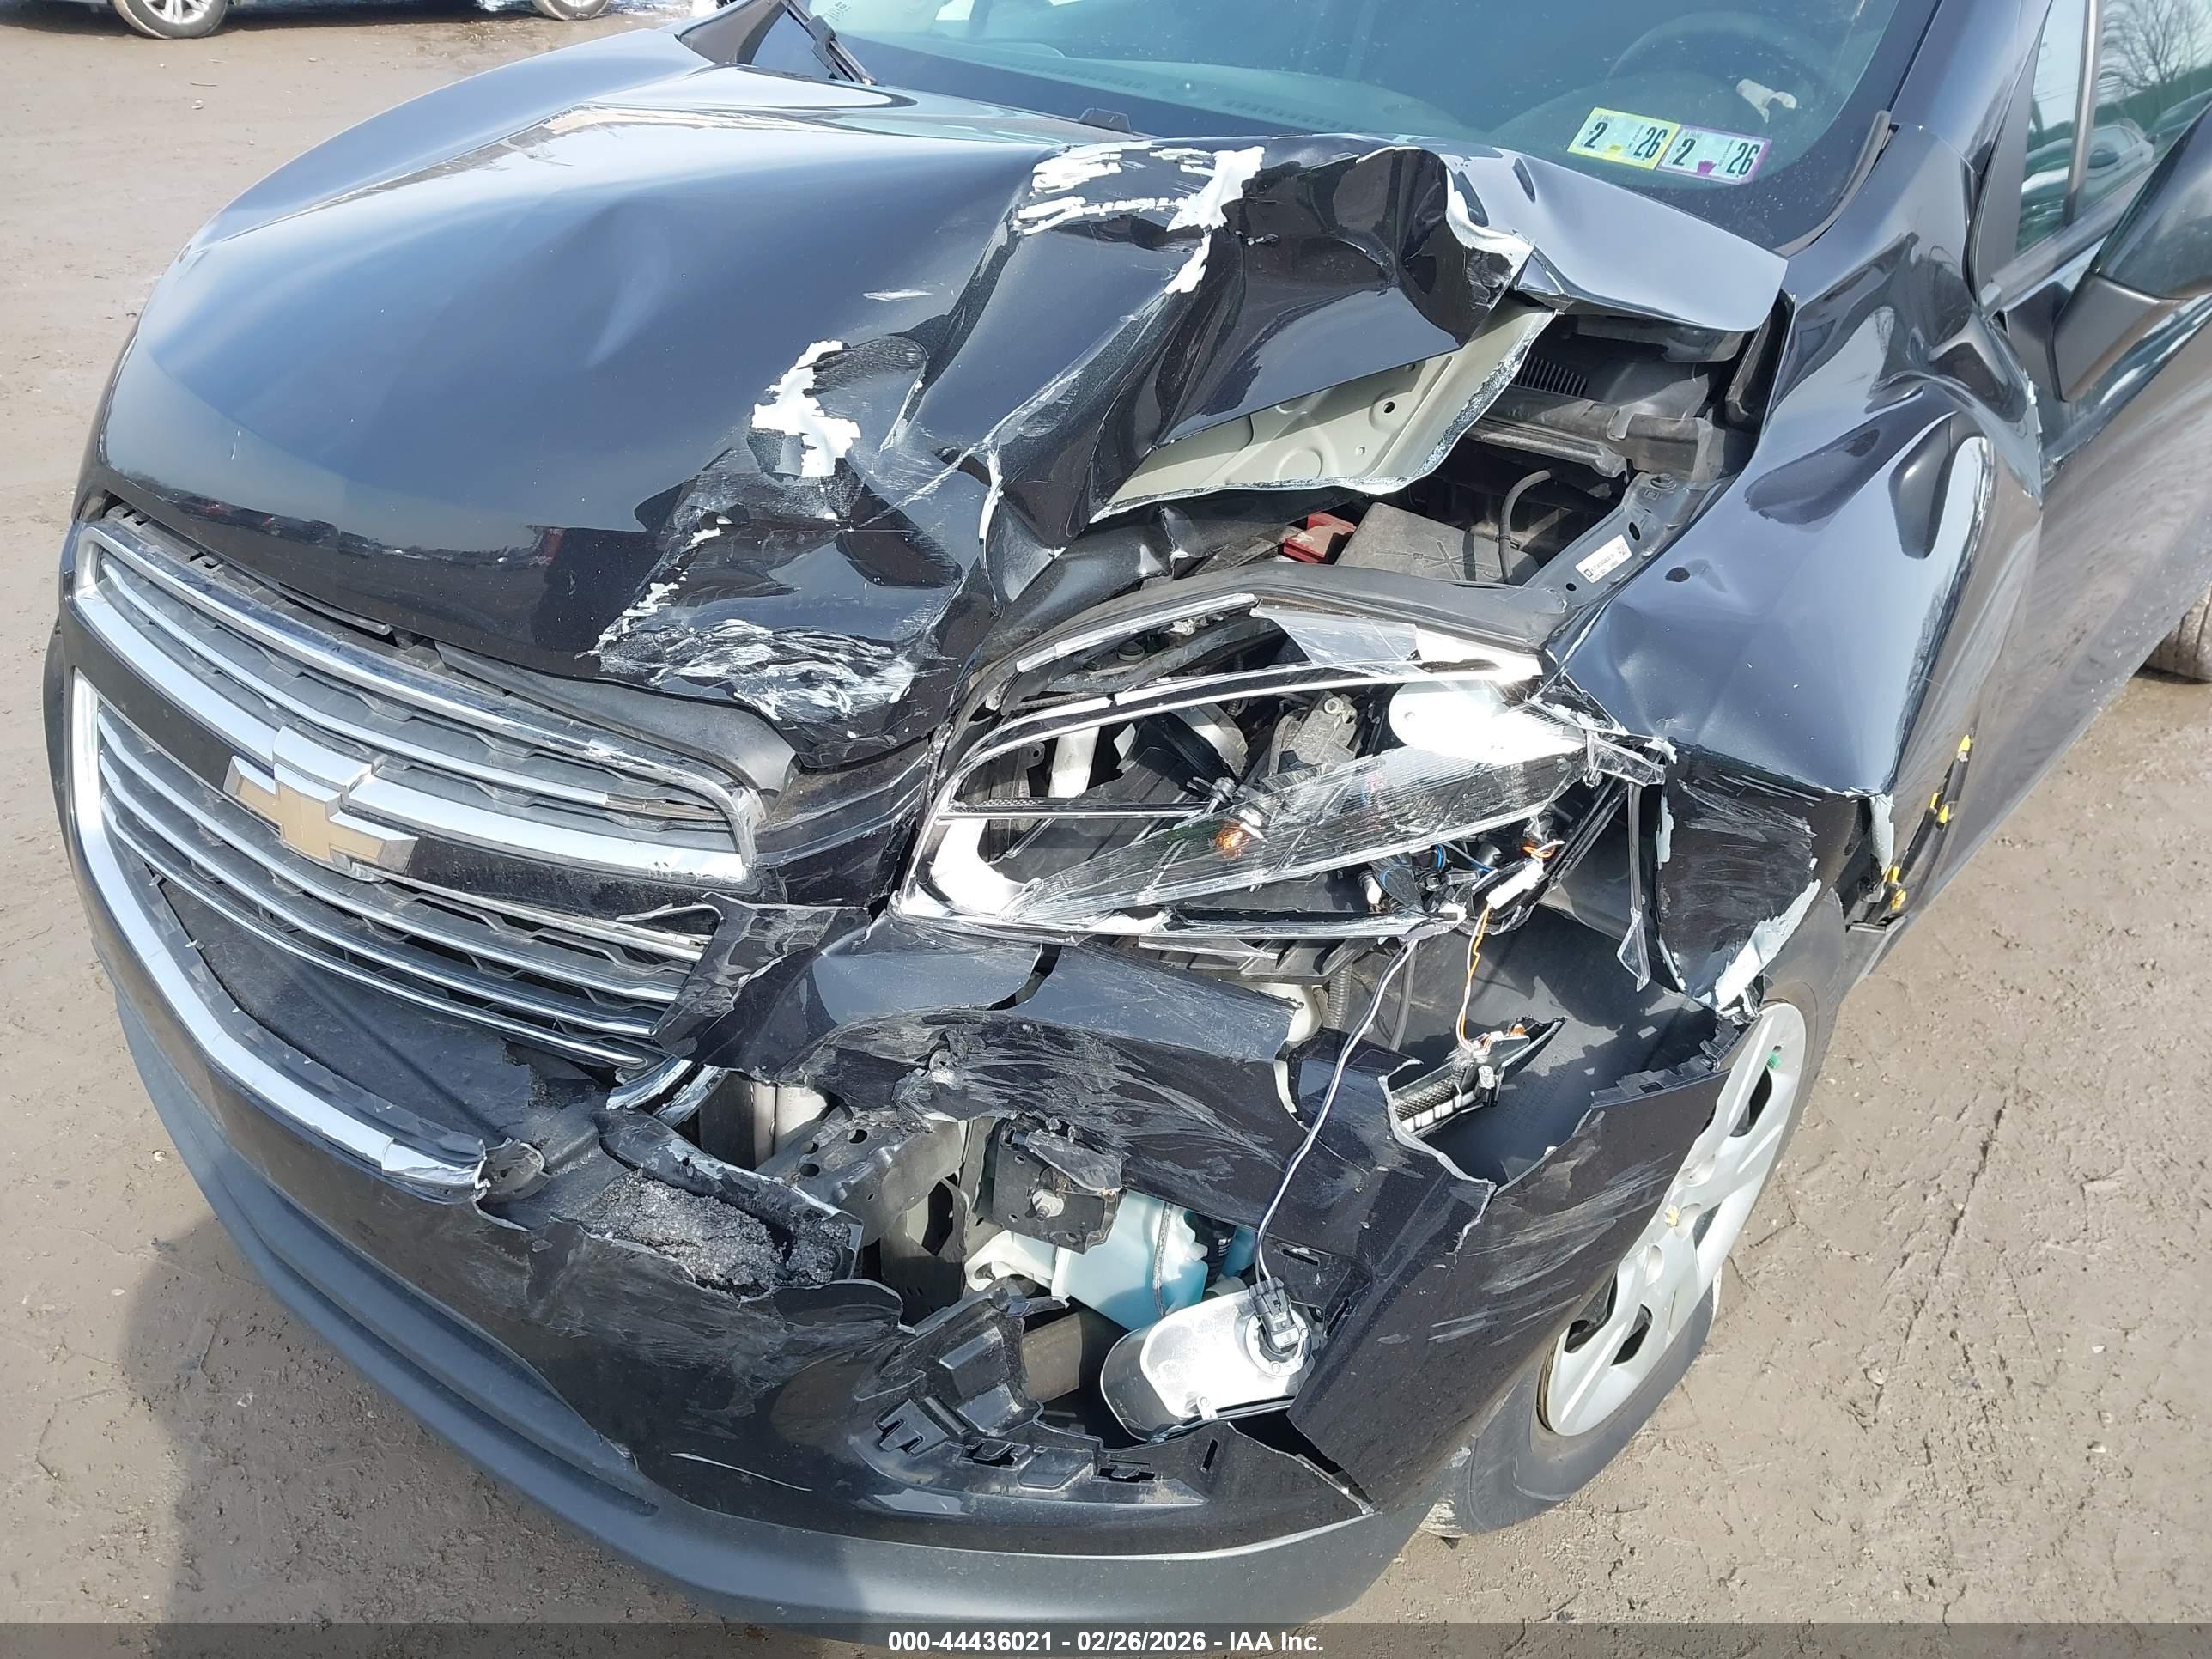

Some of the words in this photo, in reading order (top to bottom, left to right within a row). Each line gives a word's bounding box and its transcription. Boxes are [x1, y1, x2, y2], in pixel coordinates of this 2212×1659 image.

[1583, 122, 1609, 148] 2
[1633, 126, 1669, 159] 26
[1672, 138, 1697, 166] 2
[1726, 142, 1761, 175] 26
